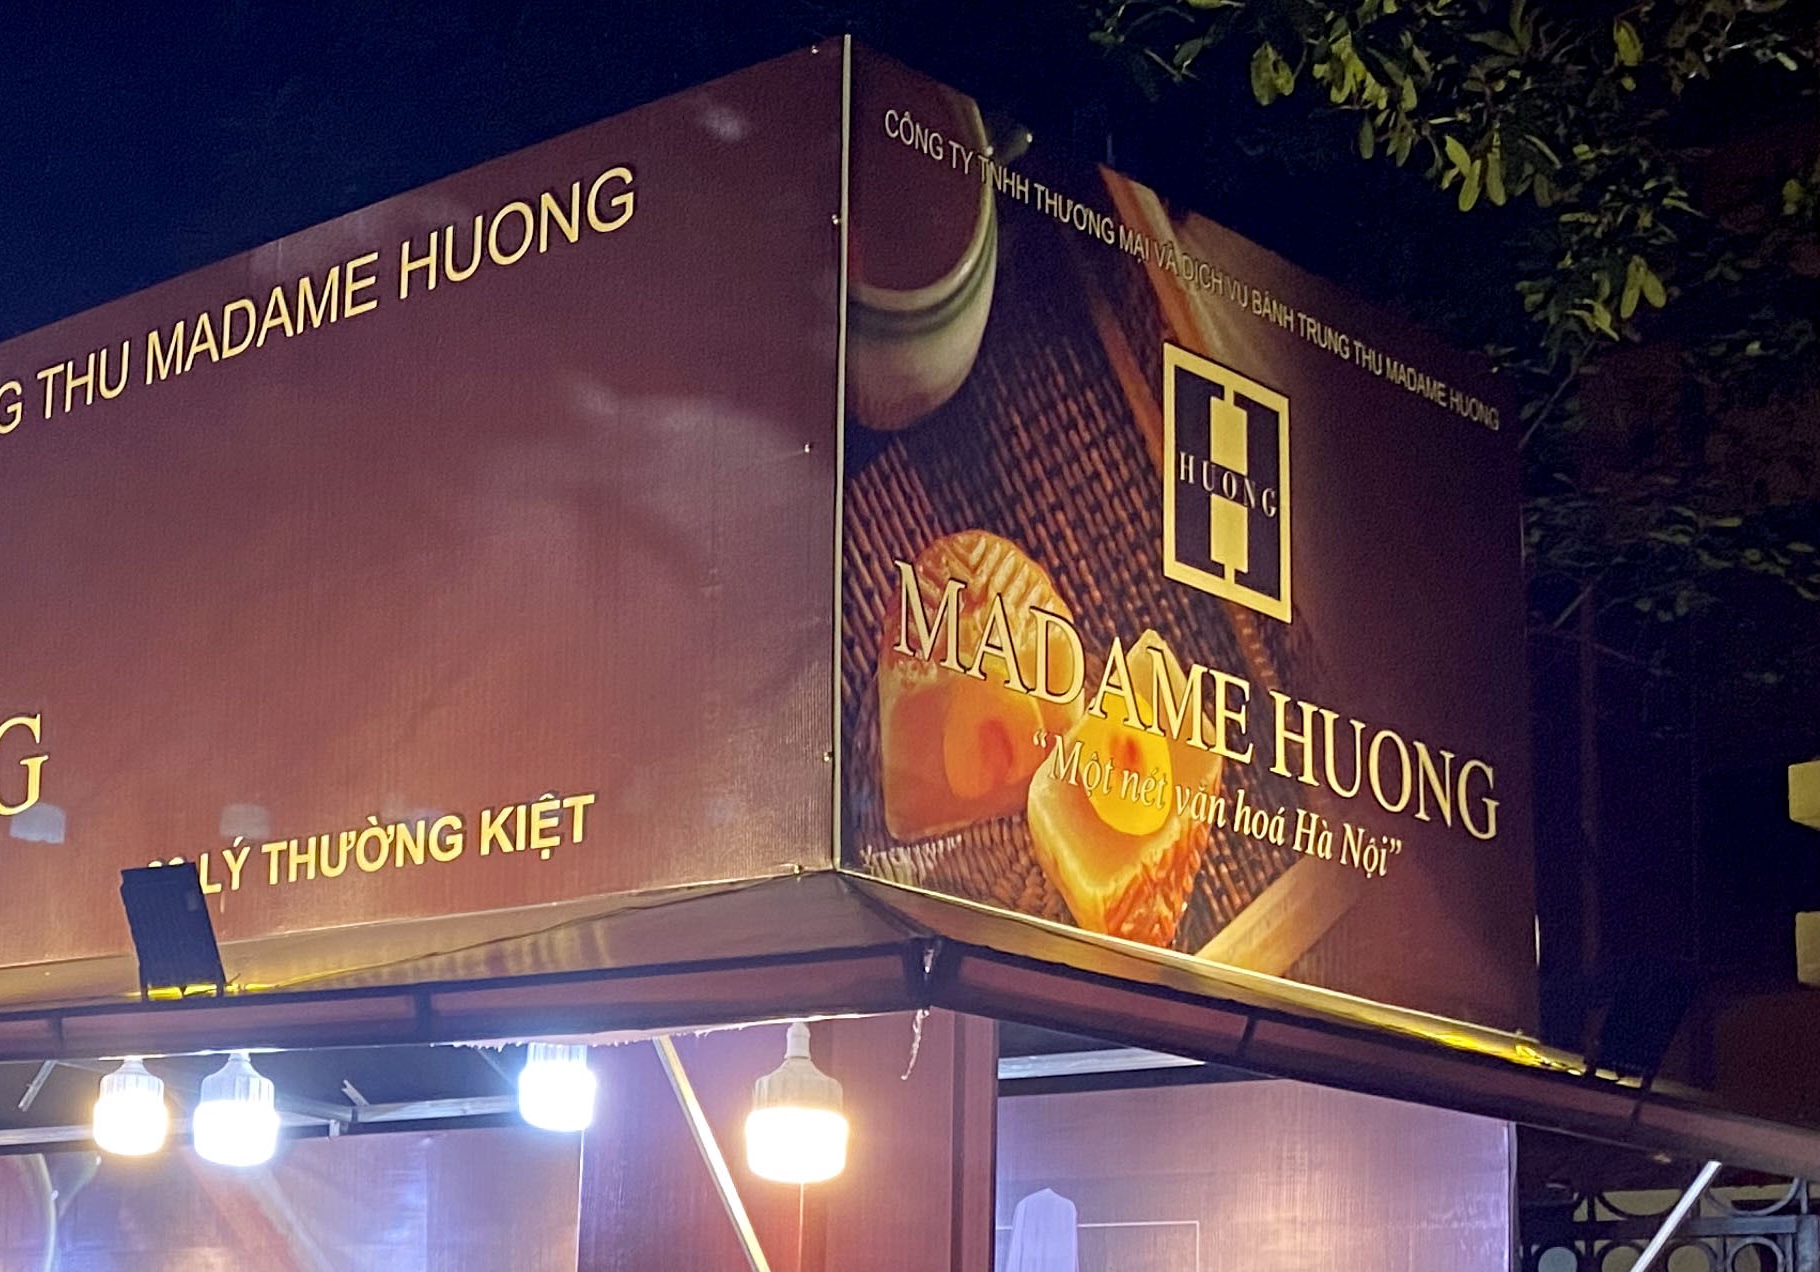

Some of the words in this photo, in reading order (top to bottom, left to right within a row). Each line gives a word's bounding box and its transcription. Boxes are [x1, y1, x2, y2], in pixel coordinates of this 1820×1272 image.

[35, 339, 130, 420] THU
[143, 250, 381, 387] MADAME
[397, 165, 637, 300] HUONG
[884, 109, 944, 161] CÔNG
[948, 139, 974, 175] TY
[977, 154, 1030, 204] TNHH
[1033, 182, 1116, 245] THƯƠNG
[1119, 224, 1150, 265] MẠI
[1152, 240, 1179, 274] VÀ
[1251, 288, 1295, 333] BÁNH
[1297, 312, 1351, 360] TRUNG
[1353, 339, 1384, 375] THU
[1385, 356, 1448, 408] MADAME
[1449, 388, 1500, 431] HUONG
[1180, 450, 1277, 518] HUONG
[892, 559, 1255, 766] MADAME
[1267, 688, 1501, 841] HUONG
[199, 835, 252, 895] LÝ
[261, 813, 465, 887] THƯỜNG
[479, 793, 596, 861] KIỆT
[1119, 764, 1168, 813] nét
[1173, 784, 1228, 832] văn
[1234, 786, 1286, 848] hoá
[1293, 807, 1334, 863] Hà
